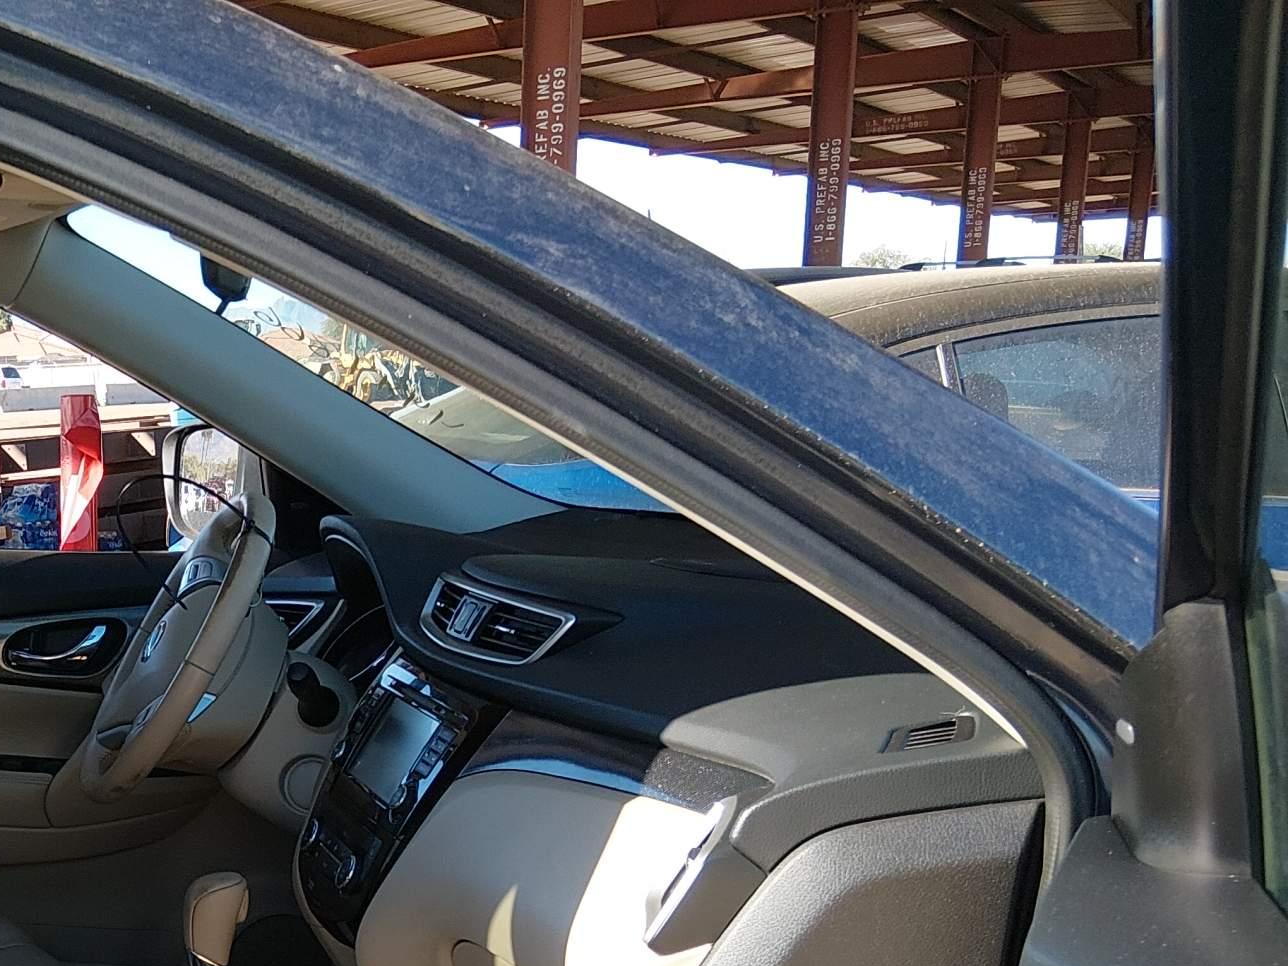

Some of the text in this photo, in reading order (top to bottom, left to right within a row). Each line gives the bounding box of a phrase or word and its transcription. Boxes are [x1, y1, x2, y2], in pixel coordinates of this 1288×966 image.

[534, 67, 551, 160] EFAB INC.
[551, 67, 566, 165] -799-0969
[814, 138, 831, 243] U.S. PREFAB INC.
[825, 138, 842, 241] 1-866-799-0969
[965, 189, 976, 225] PREFAB
